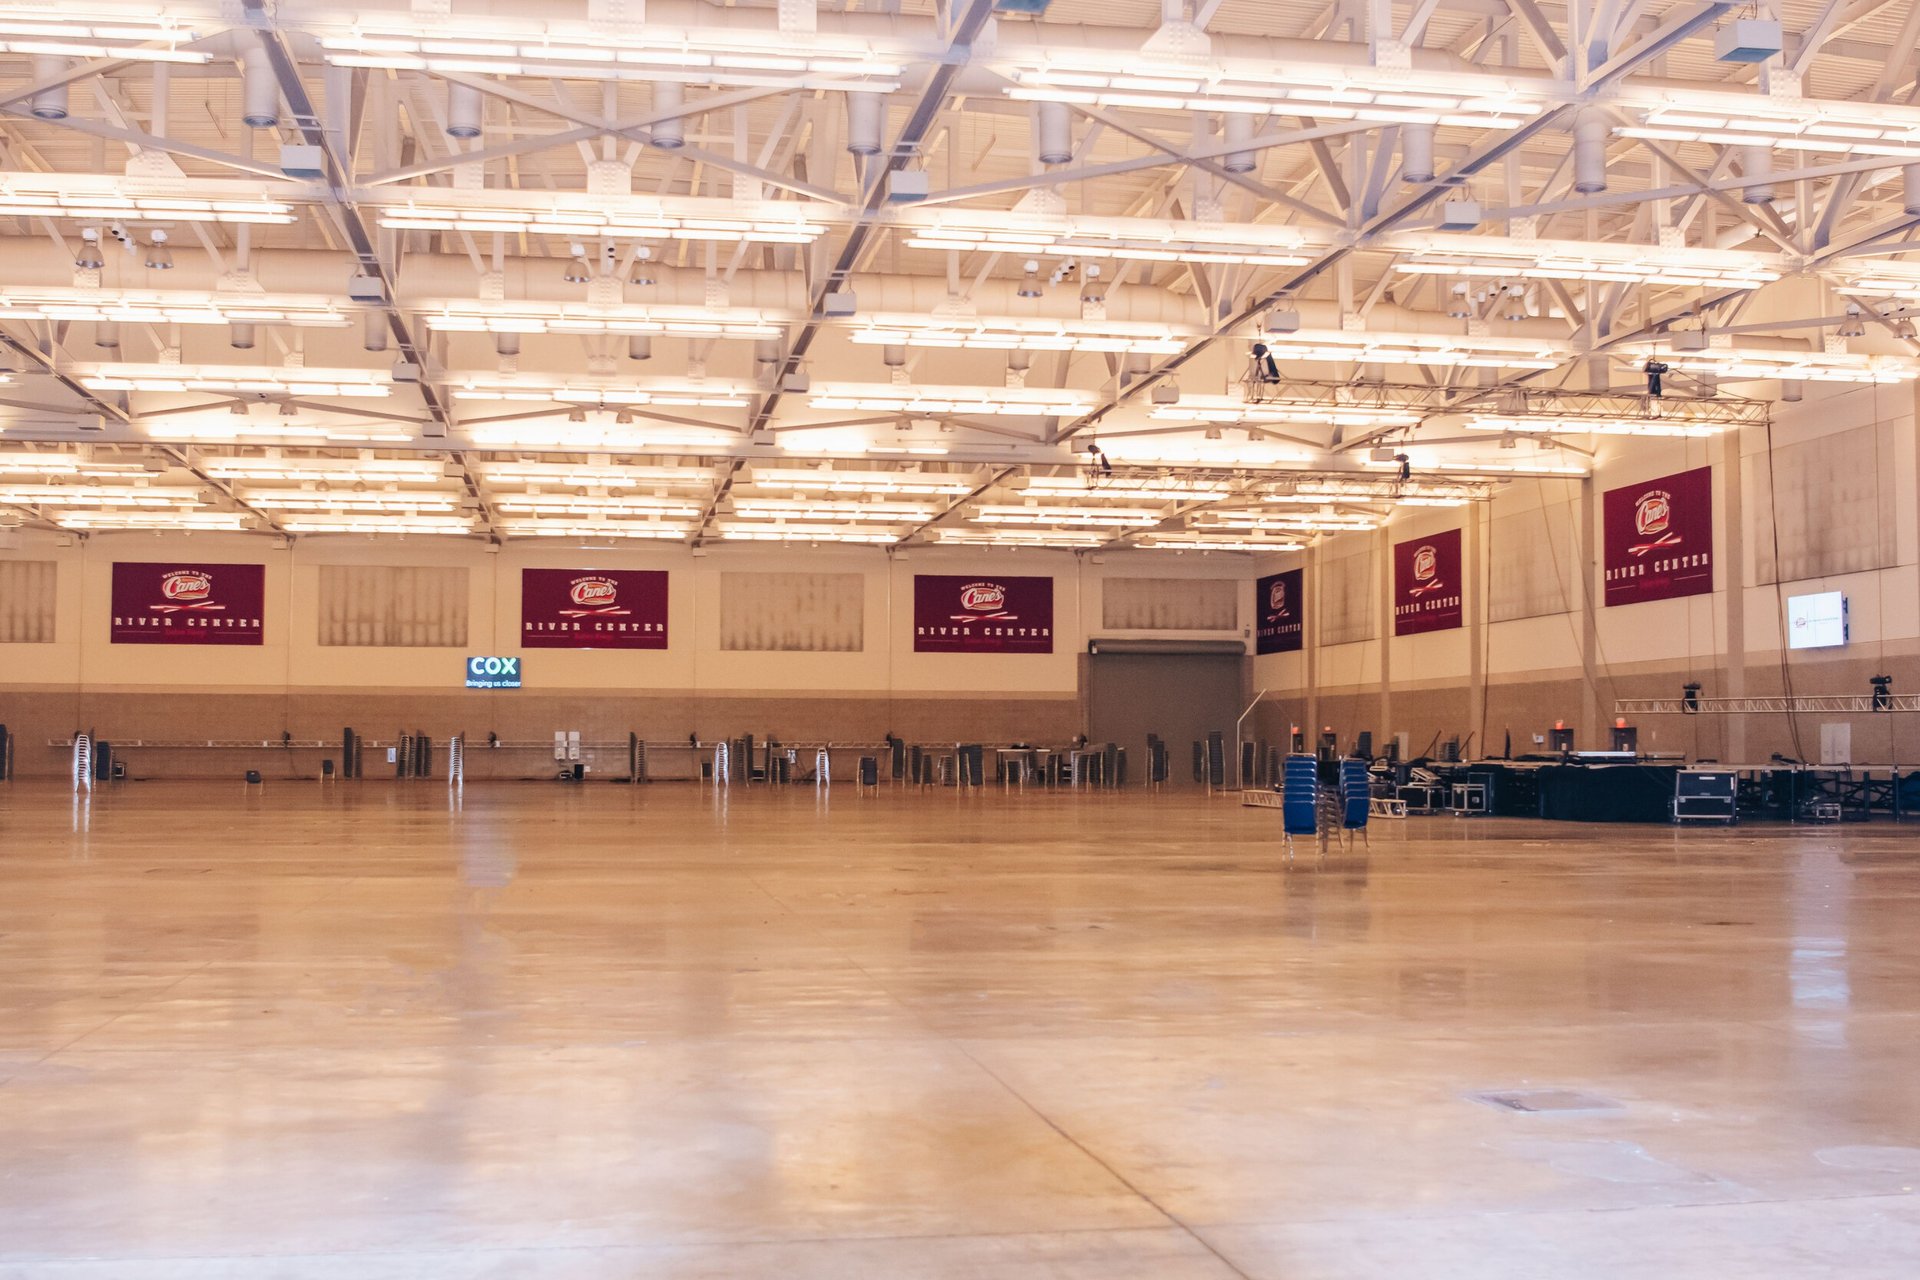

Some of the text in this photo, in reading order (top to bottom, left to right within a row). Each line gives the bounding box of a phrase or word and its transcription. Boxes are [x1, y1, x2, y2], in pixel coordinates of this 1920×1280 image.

[1606, 553, 1708, 581] RIVER CENTER
[162, 570, 190, 579] WELCOME
[1425, 596, 1459, 611] CENTER
[115, 617, 260, 627] RIVER CENTER
[525, 622, 664, 632] RIVER CENTER
[918, 627, 1049, 636] RIVER CENTER
[470, 656, 517, 675] COX
[466, 679, 493, 688] Bringing
[501, 679, 521, 687] closer
